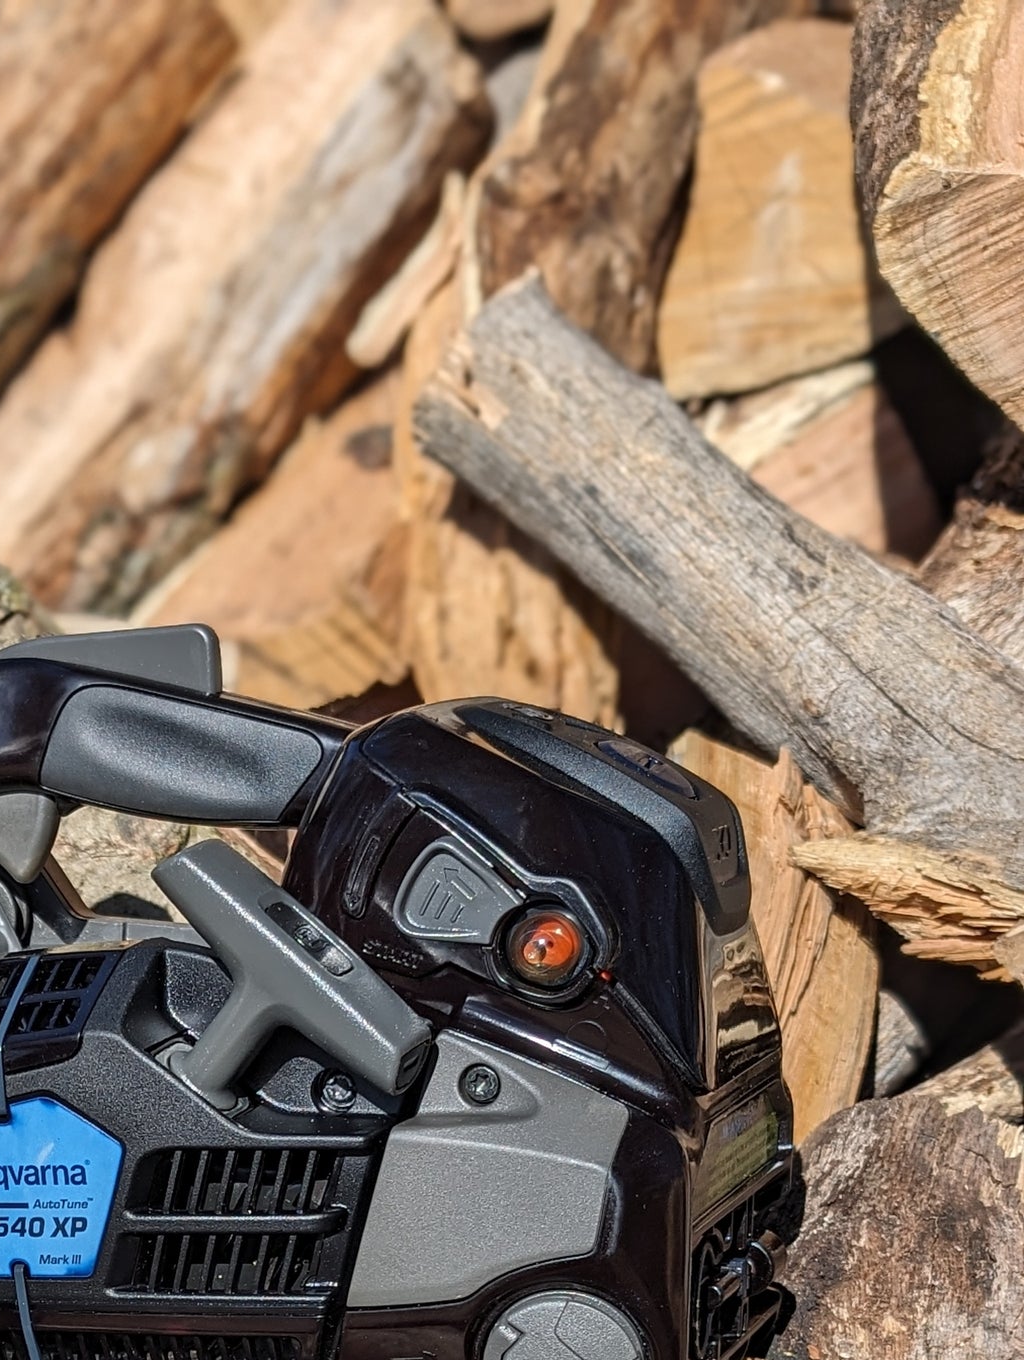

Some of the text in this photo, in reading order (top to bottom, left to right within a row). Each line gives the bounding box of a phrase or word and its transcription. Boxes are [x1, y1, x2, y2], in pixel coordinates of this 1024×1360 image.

[33, 1199, 88, 1210] AutoTune
[51, 1216, 88, 1238] XP
[39, 1254, 70, 1266] Mark
